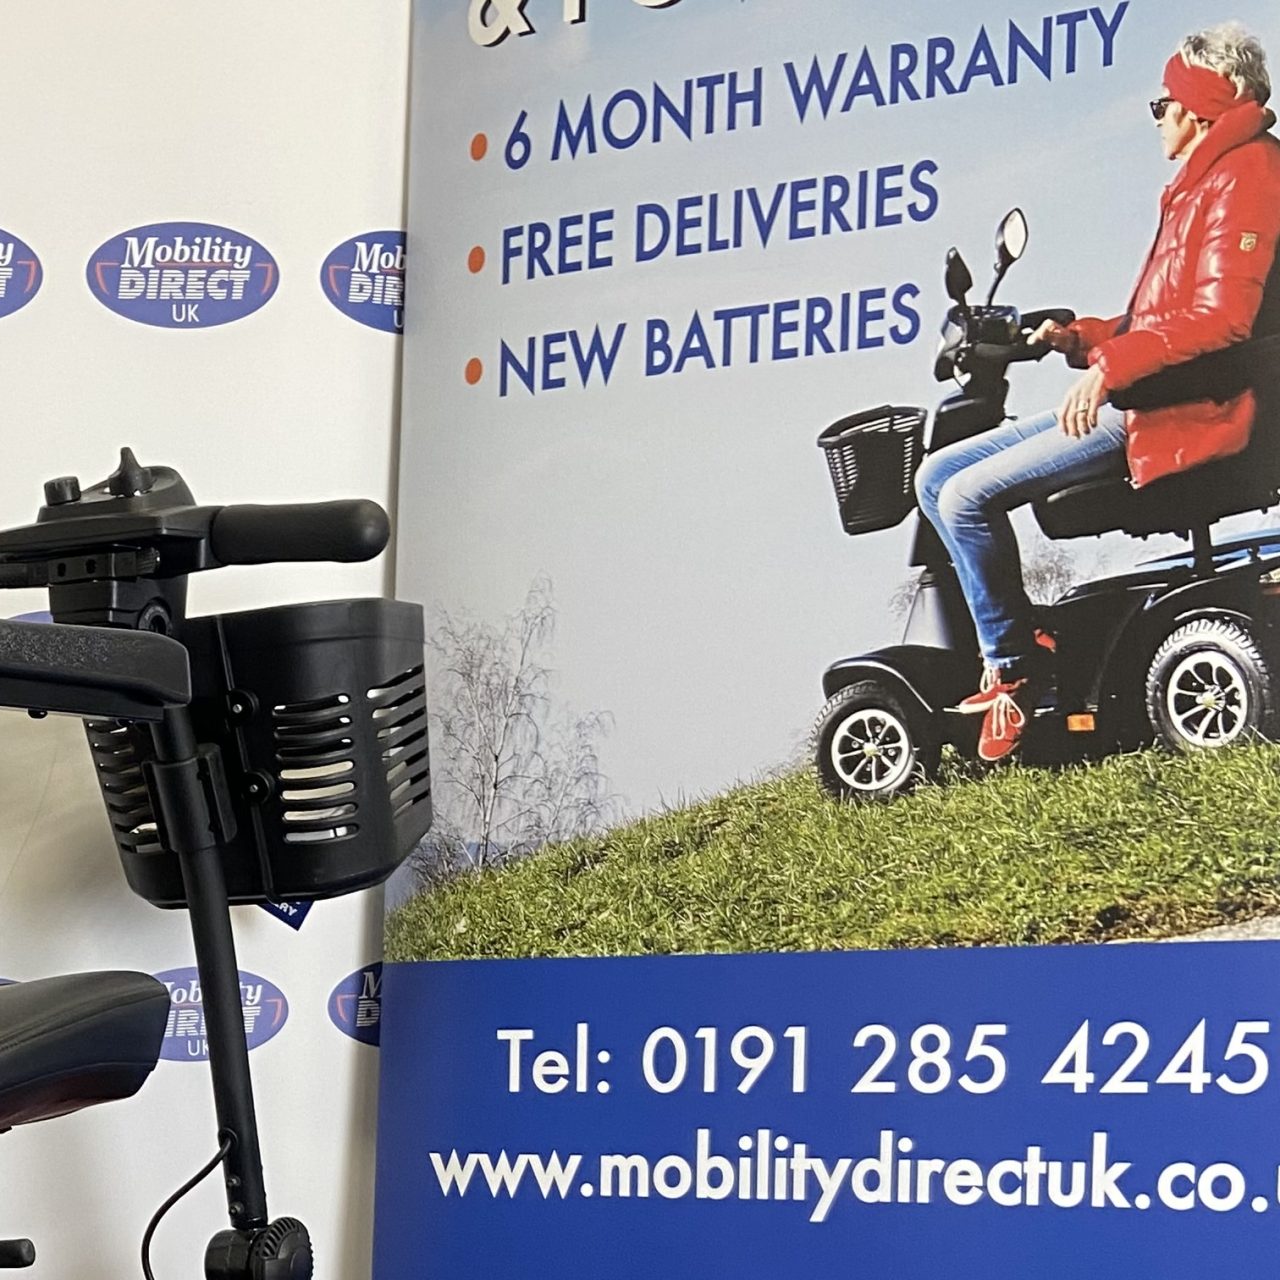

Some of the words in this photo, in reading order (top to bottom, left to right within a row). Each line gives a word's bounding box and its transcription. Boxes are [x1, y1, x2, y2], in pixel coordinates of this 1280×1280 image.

[504, 109, 532, 170] 6
[550, 67, 763, 160] MONTH
[783, 0, 1130, 125] WARRANTY
[121, 236, 252, 269] Mobility
[501, 208, 615, 286] FREE
[635, 159, 940, 263] DELIVERIES
[117, 269, 251, 300] DIRECT
[171, 303, 200, 323] UK
[498, 322, 628, 398] NEW
[645, 282, 921, 377] BATTERIES
[496, 1022, 611, 1094] Tel:
[642, 1025, 809, 1095] 0191
[851, 1023, 1008, 1095] 285
[1040, 1017, 1271, 1095] 4245
[429, 1127, 1280, 1223] www.mobilitydirectuk.co.
